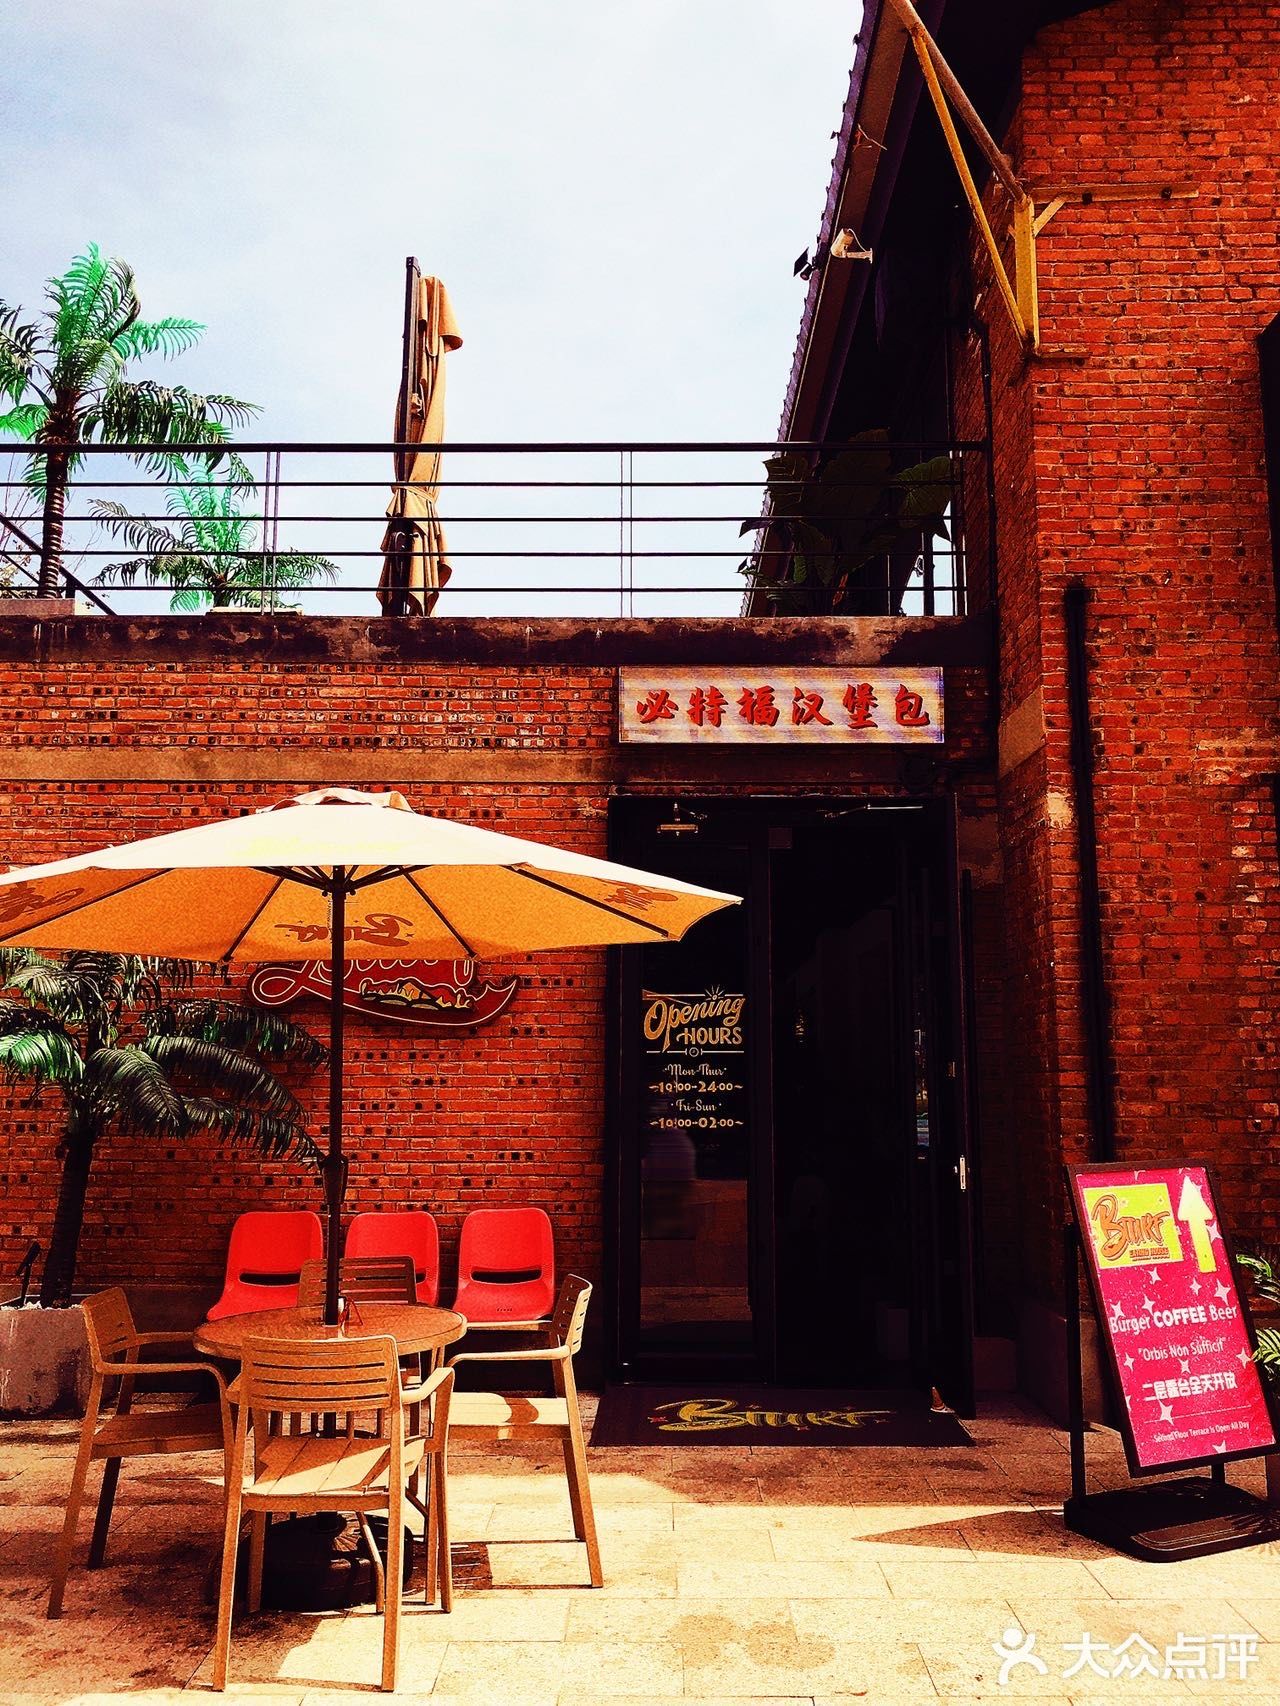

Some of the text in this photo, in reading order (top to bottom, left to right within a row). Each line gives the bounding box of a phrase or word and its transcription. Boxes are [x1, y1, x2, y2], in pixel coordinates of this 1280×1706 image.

[636, 684, 930, 729] 必特福汉堡包
[643, 998, 746, 1052] Opening
[676, 1027, 743, 1045] HOURS
[667, 1063, 724, 1076] Mon-Thur
[675, 1099, 717, 1111] Fri-Sun
[1109, 1304, 1237, 1335] Burger COFFEE Beer
[1169, 1344, 1190, 1358] Non
[1189, 1426, 1209, 1437] Terrace
[1215, 1423, 1230, 1434] Open
[1239, 1420, 1250, 1431] Day
